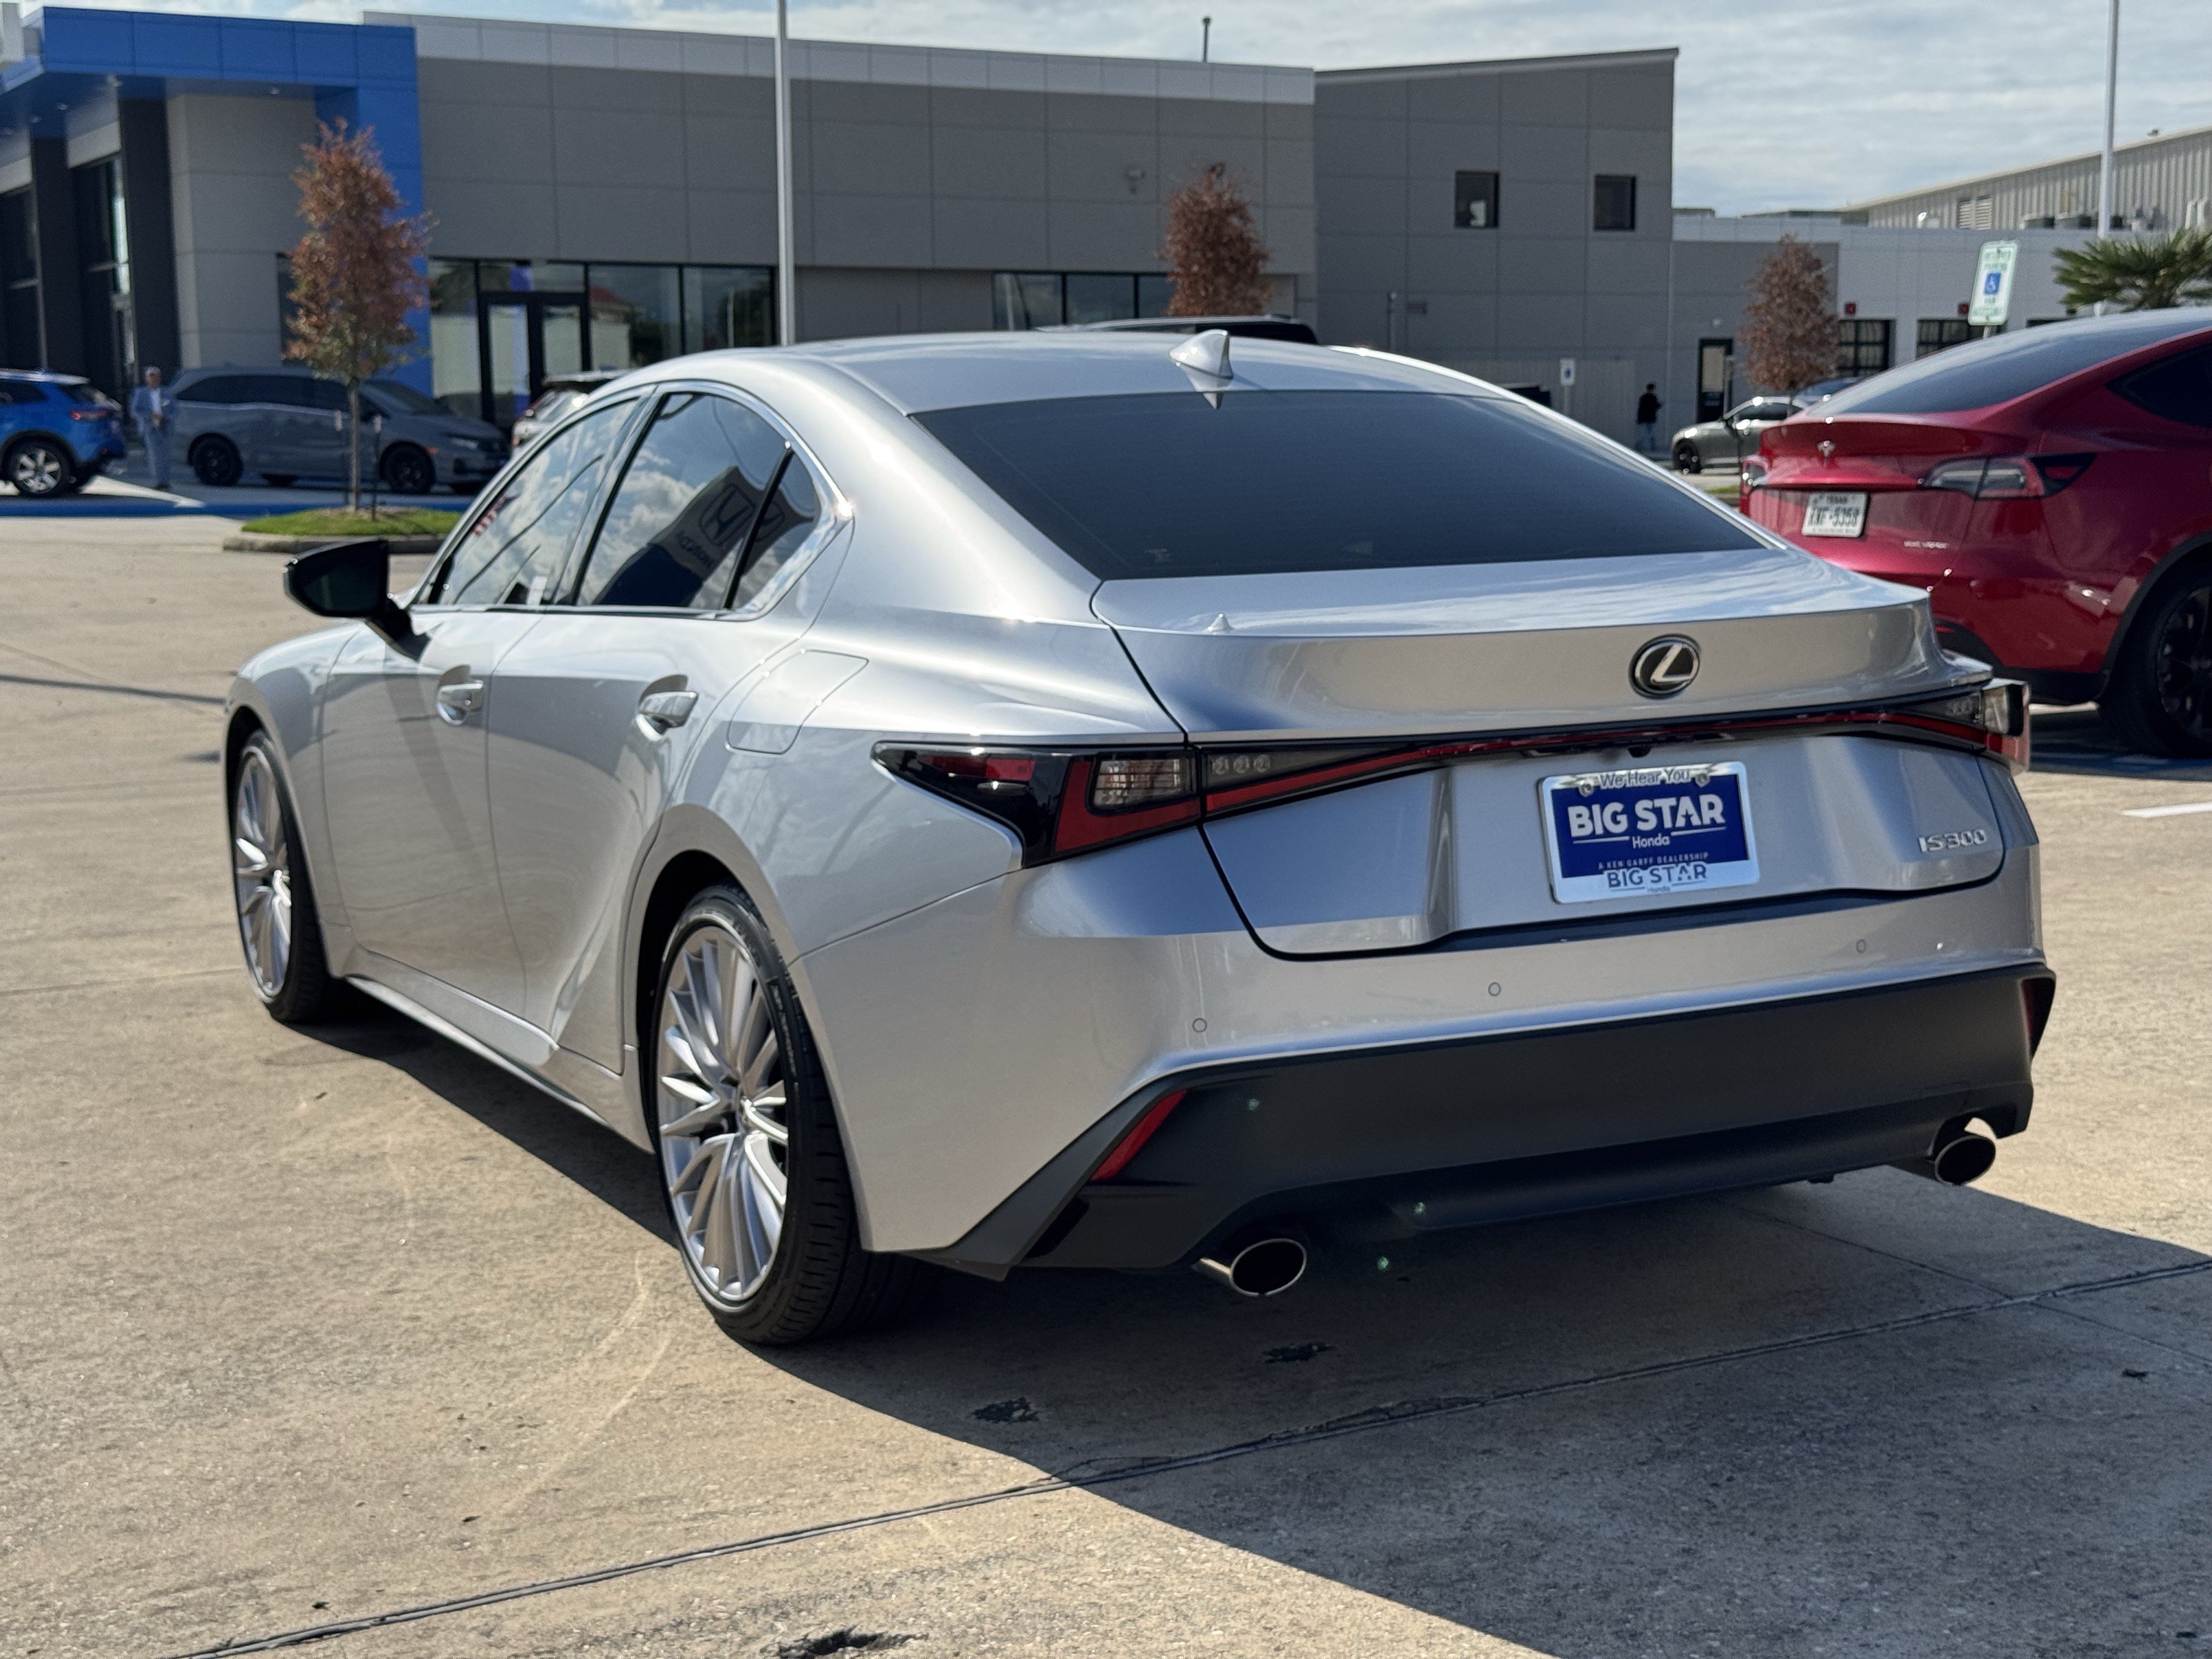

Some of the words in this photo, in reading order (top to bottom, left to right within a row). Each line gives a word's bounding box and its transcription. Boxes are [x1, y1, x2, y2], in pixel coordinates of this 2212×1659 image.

[1599, 774, 1623, 789] We
[1628, 771, 1661, 787] Hear
[1663, 768, 1691, 784] You
[1567, 802, 1628, 838] BIG
[1634, 794, 1726, 831] STAR
[1632, 833, 1671, 849] Honda
[1607, 860, 1623, 868] KEN
[1627, 857, 1654, 867] GARFF
[1657, 852, 1709, 864] DEALERSHIP
[1607, 869, 1644, 888] BIG
[1650, 865, 1707, 883] STAR
